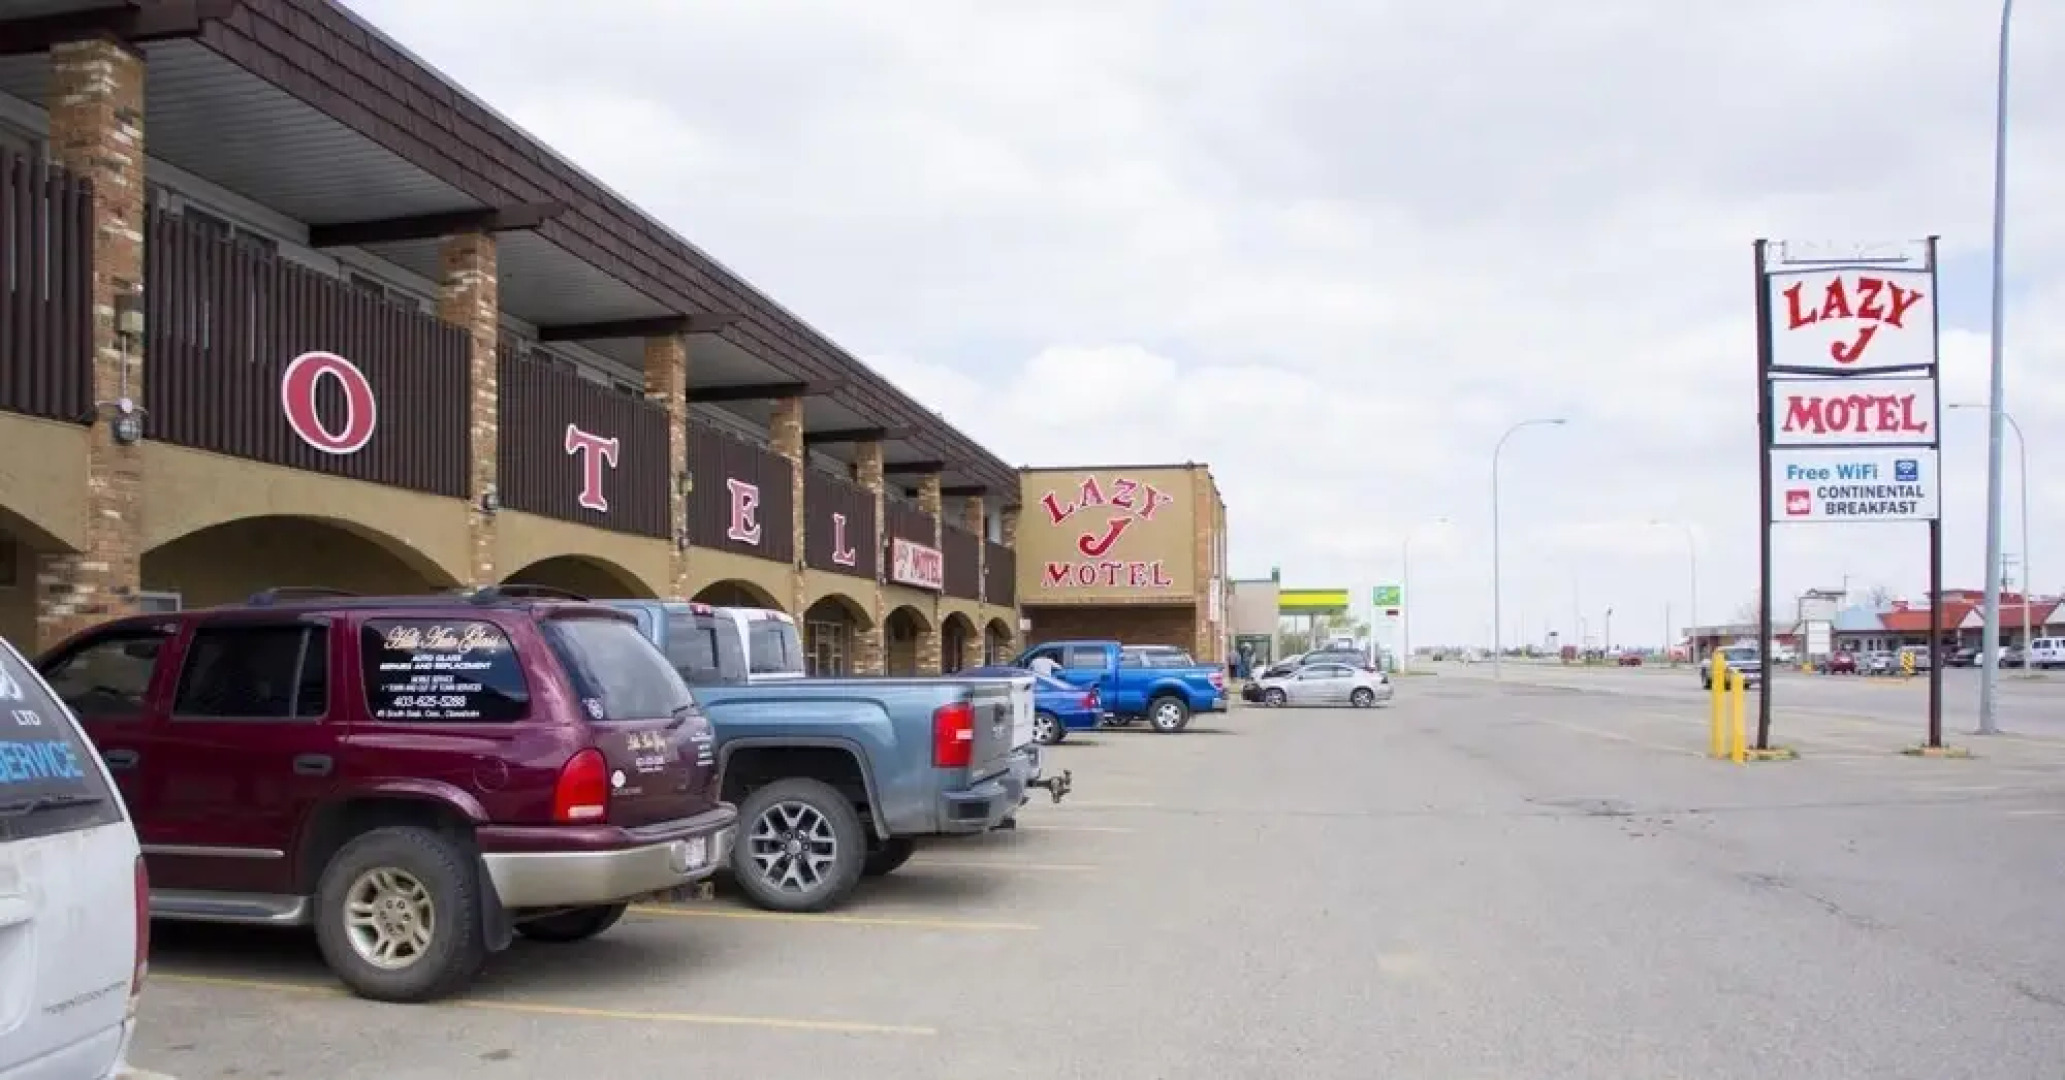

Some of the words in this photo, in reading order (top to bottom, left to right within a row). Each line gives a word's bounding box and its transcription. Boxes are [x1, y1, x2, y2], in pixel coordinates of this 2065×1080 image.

[1783, 275, 1924, 331] LAZY
[1830, 324, 1878, 364] J
[1782, 394, 1928, 434] MOTEL
[1787, 464, 1830, 480] Free
[1836, 463, 1879, 480] WiFi
[1041, 475, 1174, 528] LAZY
[1817, 485, 1925, 499] CONTINENTAL
[1825, 501, 1918, 515] BREAKFAST
[1078, 516, 1134, 558] J
[1041, 561, 1174, 588] MOTEL
[11, 709, 42, 726] LTD
